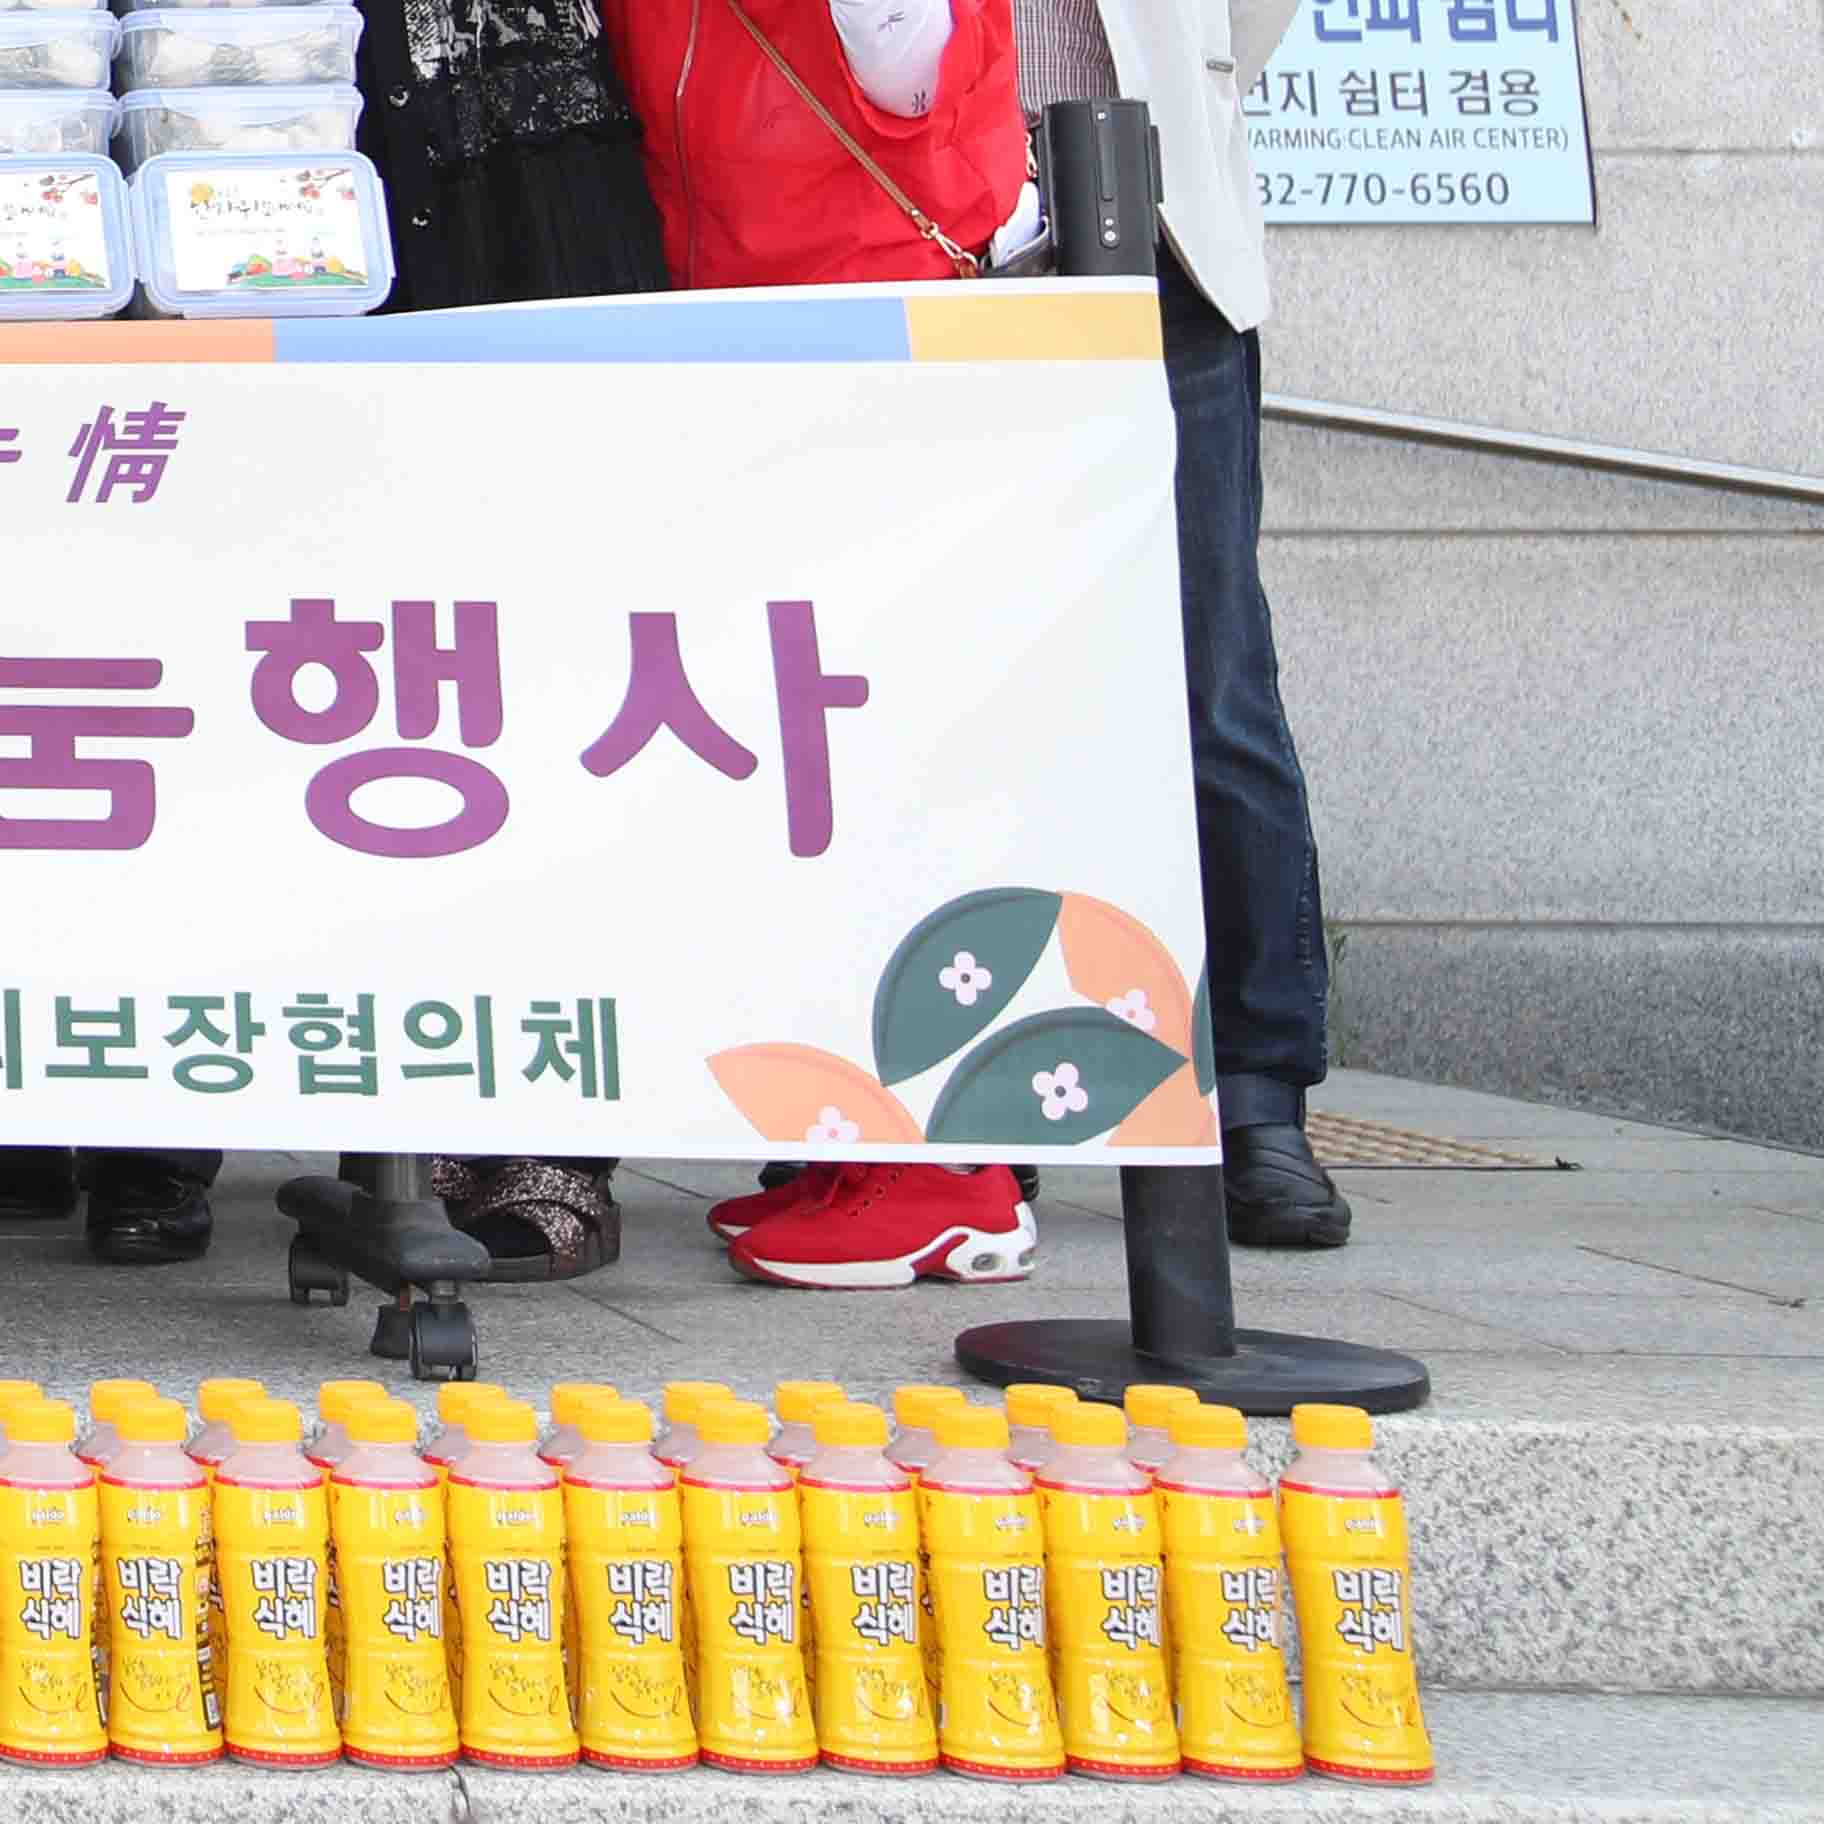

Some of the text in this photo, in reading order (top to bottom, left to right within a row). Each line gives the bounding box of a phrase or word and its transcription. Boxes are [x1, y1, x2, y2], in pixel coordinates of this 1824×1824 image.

[1339, 69, 1428, 117] 쉼터
[1449, 69, 1540, 117] 겸용
[1429, 128, 1466, 150] AIR
[1473, 126, 1569, 152] CENTER)
[69, 401, 184, 504] 情
[21, 1557, 81, 1599] 비락
[119, 1556, 184, 1599] 비락
[252, 1556, 316, 1598] 비락
[383, 1558, 442, 1601] 비락
[486, 1557, 550, 1600] 비락
[608, 1558, 673, 1601] 비락
[730, 1560, 794, 1603] 비락
[852, 1560, 915, 1603] 비락
[1335, 1567, 1402, 1611] 비락
[21, 1596, 79, 1639] 식혜
[119, 1595, 182, 1639] 식혜
[252, 1595, 314, 1638] 식혜
[383, 1597, 440, 1641] 식혜
[486, 1596, 548, 1640] 식혜
[608, 1597, 671, 1641] 식혜
[730, 1599, 792, 1643] 식혜
[852, 1599, 913, 1643] 식혜
[1335, 1608, 1400, 1653] 식혜
